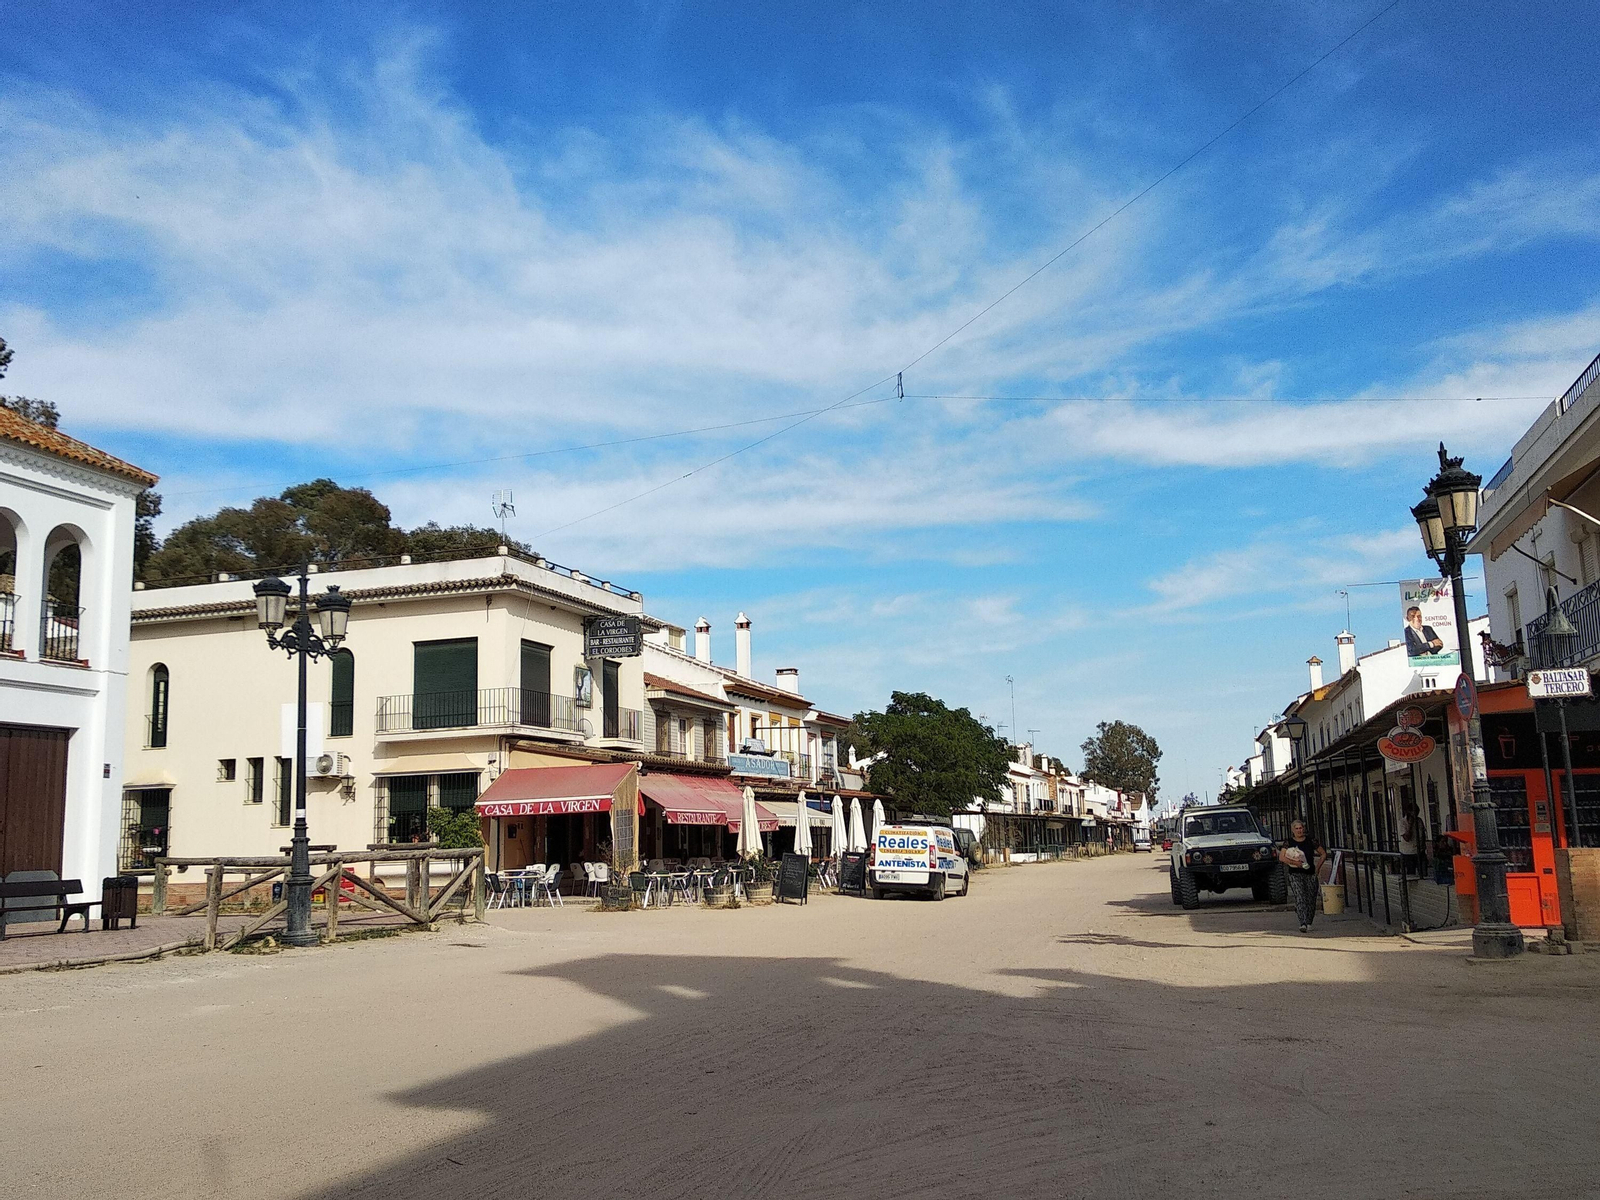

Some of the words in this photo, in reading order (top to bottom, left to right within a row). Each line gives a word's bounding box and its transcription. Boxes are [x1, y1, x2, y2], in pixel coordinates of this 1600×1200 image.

[602, 637, 635, 645] RESTAURANTE
[1542, 670, 1585, 683] BALTASAR
[1544, 682, 1585, 694] TERCERO
[1385, 741, 1429, 757] POLVILLO
[745, 759, 775, 769] ASADOR
[485, 804, 513, 816] CASA
[519, 803, 534, 815] DE
[539, 802, 554, 814] LA
[560, 799, 600, 812] VIRGEN
[677, 812, 717, 824] RESTAURANTE
[878, 835, 928, 849] Reales
[878, 860, 927, 868] ANTENISTA
